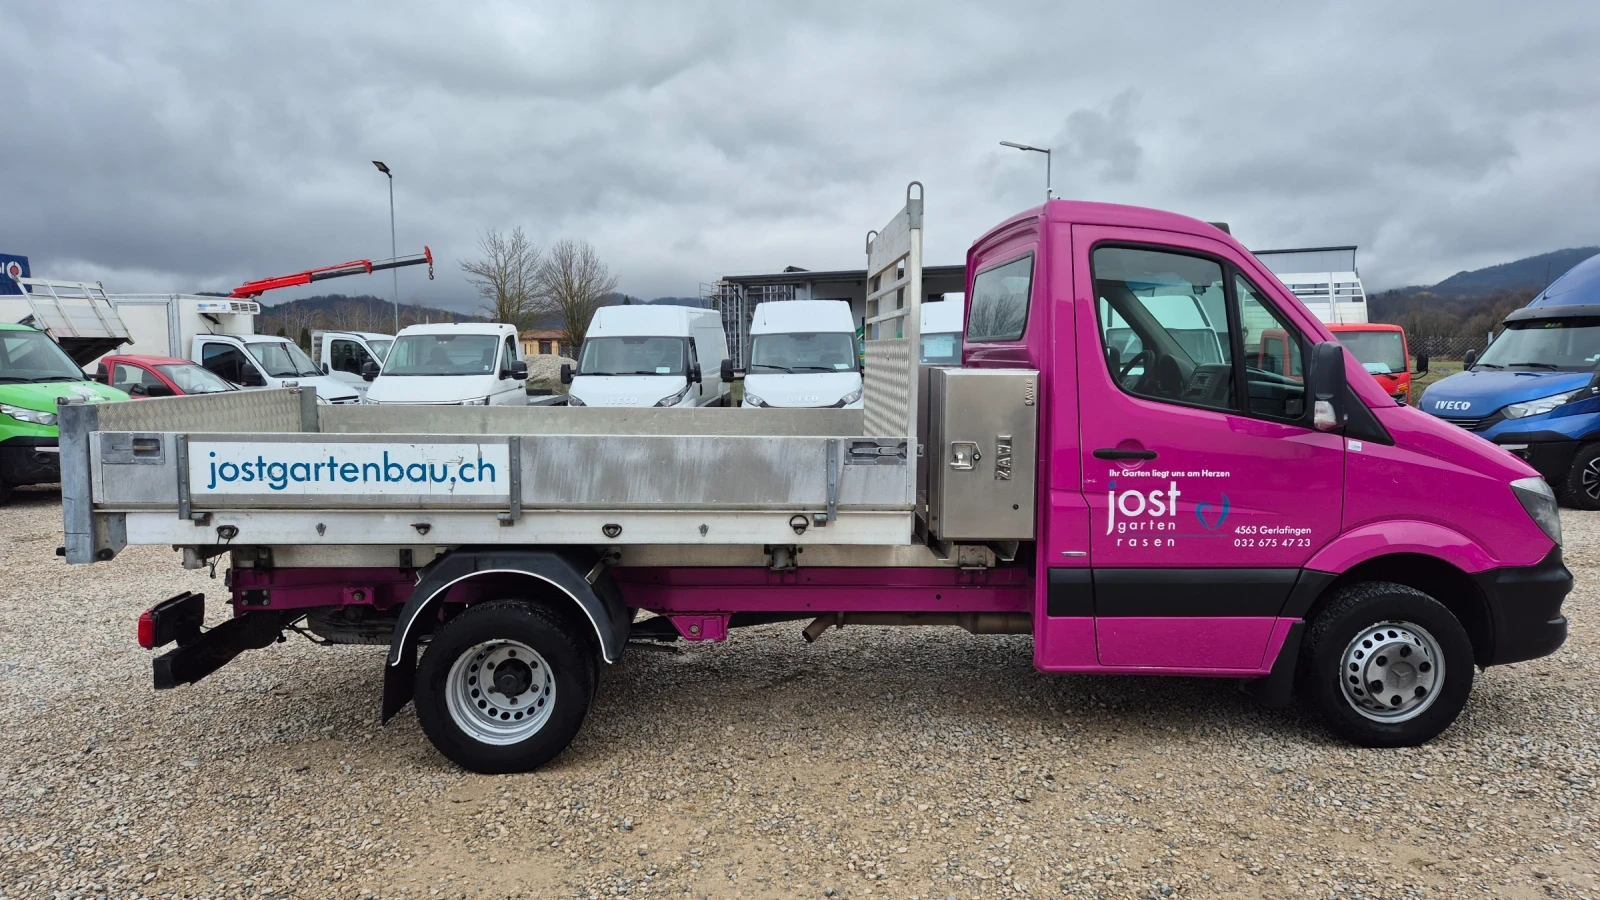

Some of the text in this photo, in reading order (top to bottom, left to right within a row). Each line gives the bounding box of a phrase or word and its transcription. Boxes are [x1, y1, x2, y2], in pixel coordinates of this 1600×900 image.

[605, 396, 638, 405] IVECO
[785, 395, 819, 404] IVECO
[1434, 400, 1472, 411] IVECO
[207, 451, 496, 490] jostgartenbau.ch
[1109, 469, 1121, 477] Ihr
[1122, 469, 1151, 477] Garten
[1151, 469, 1170, 479] liegt
[1201, 470, 1231, 478] Herzen
[1106, 481, 1181, 536] jost
[1117, 519, 1176, 534] garten
[1234, 525, 1312, 537] 4563 Gerlafingen
[1116, 538, 1175, 547] rasen
[1233, 538, 1311, 547] 032 675 47 23
